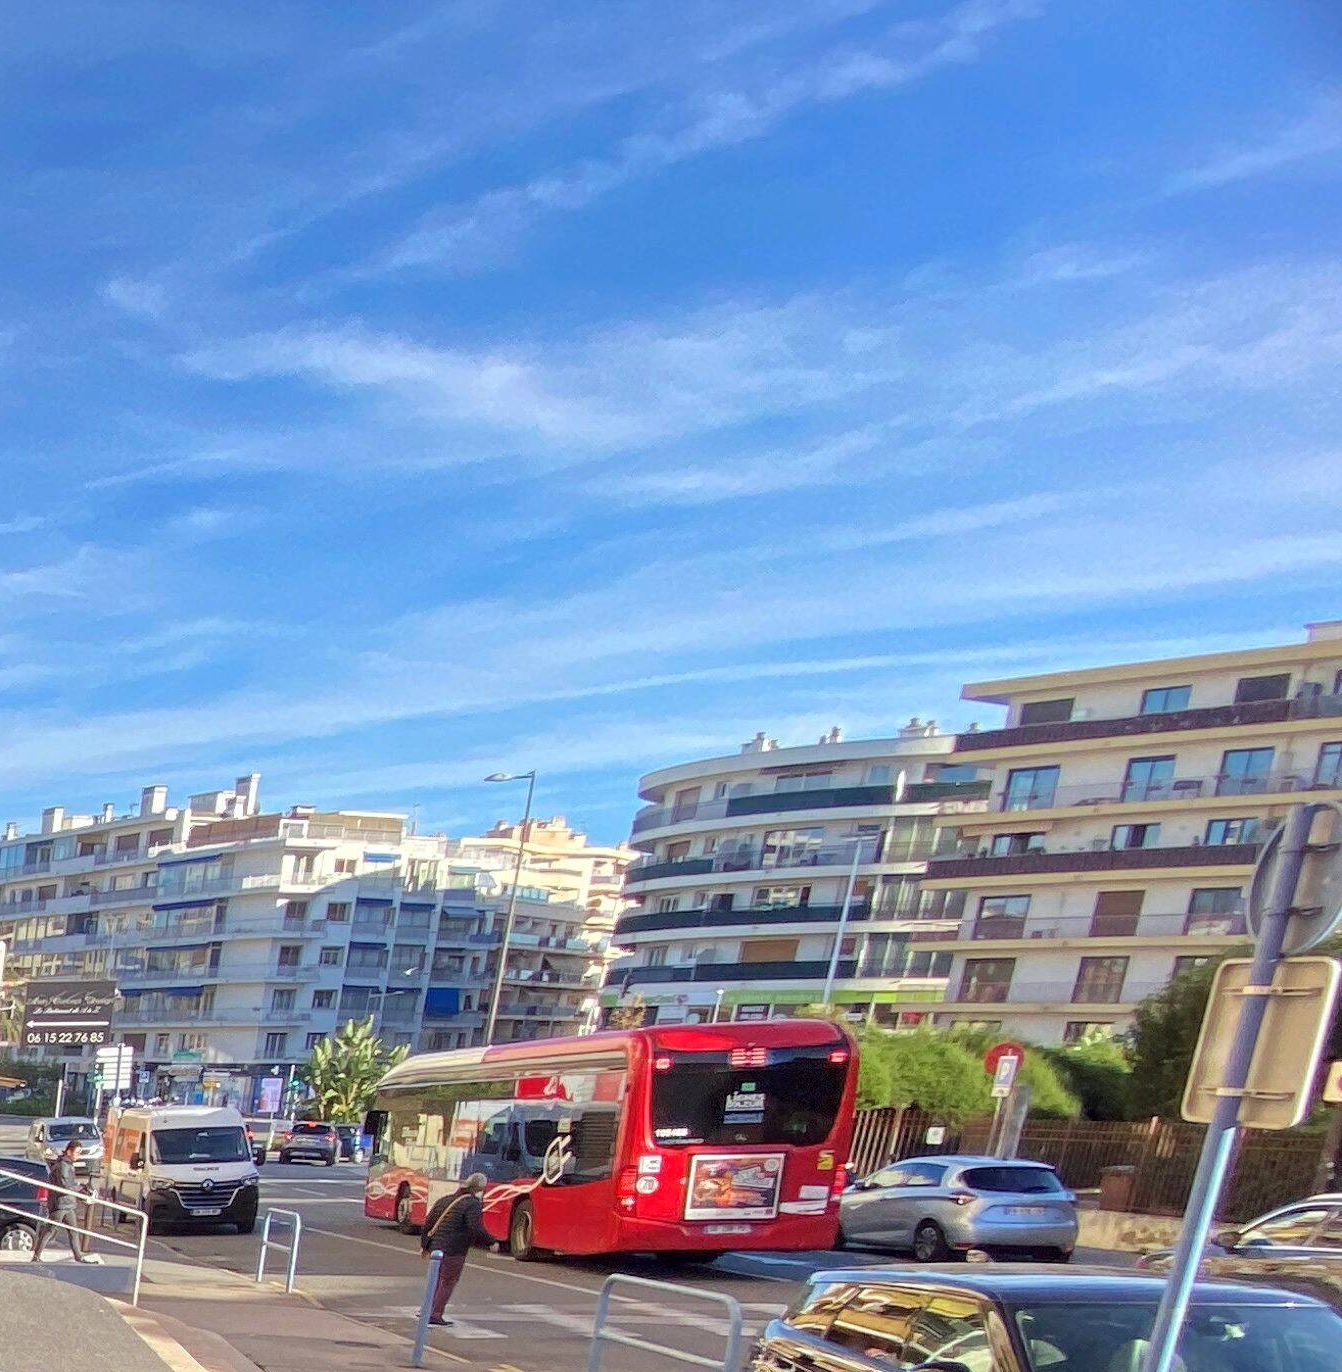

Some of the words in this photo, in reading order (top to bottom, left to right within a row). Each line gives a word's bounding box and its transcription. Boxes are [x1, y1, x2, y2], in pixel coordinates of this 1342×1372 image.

[27, 1033, 41, 1043] 06
[44, 1033, 57, 1043] 15
[58, 1033, 72, 1043] 22
[73, 1033, 89, 1043] 76
[90, 1032, 104, 1043] 85
